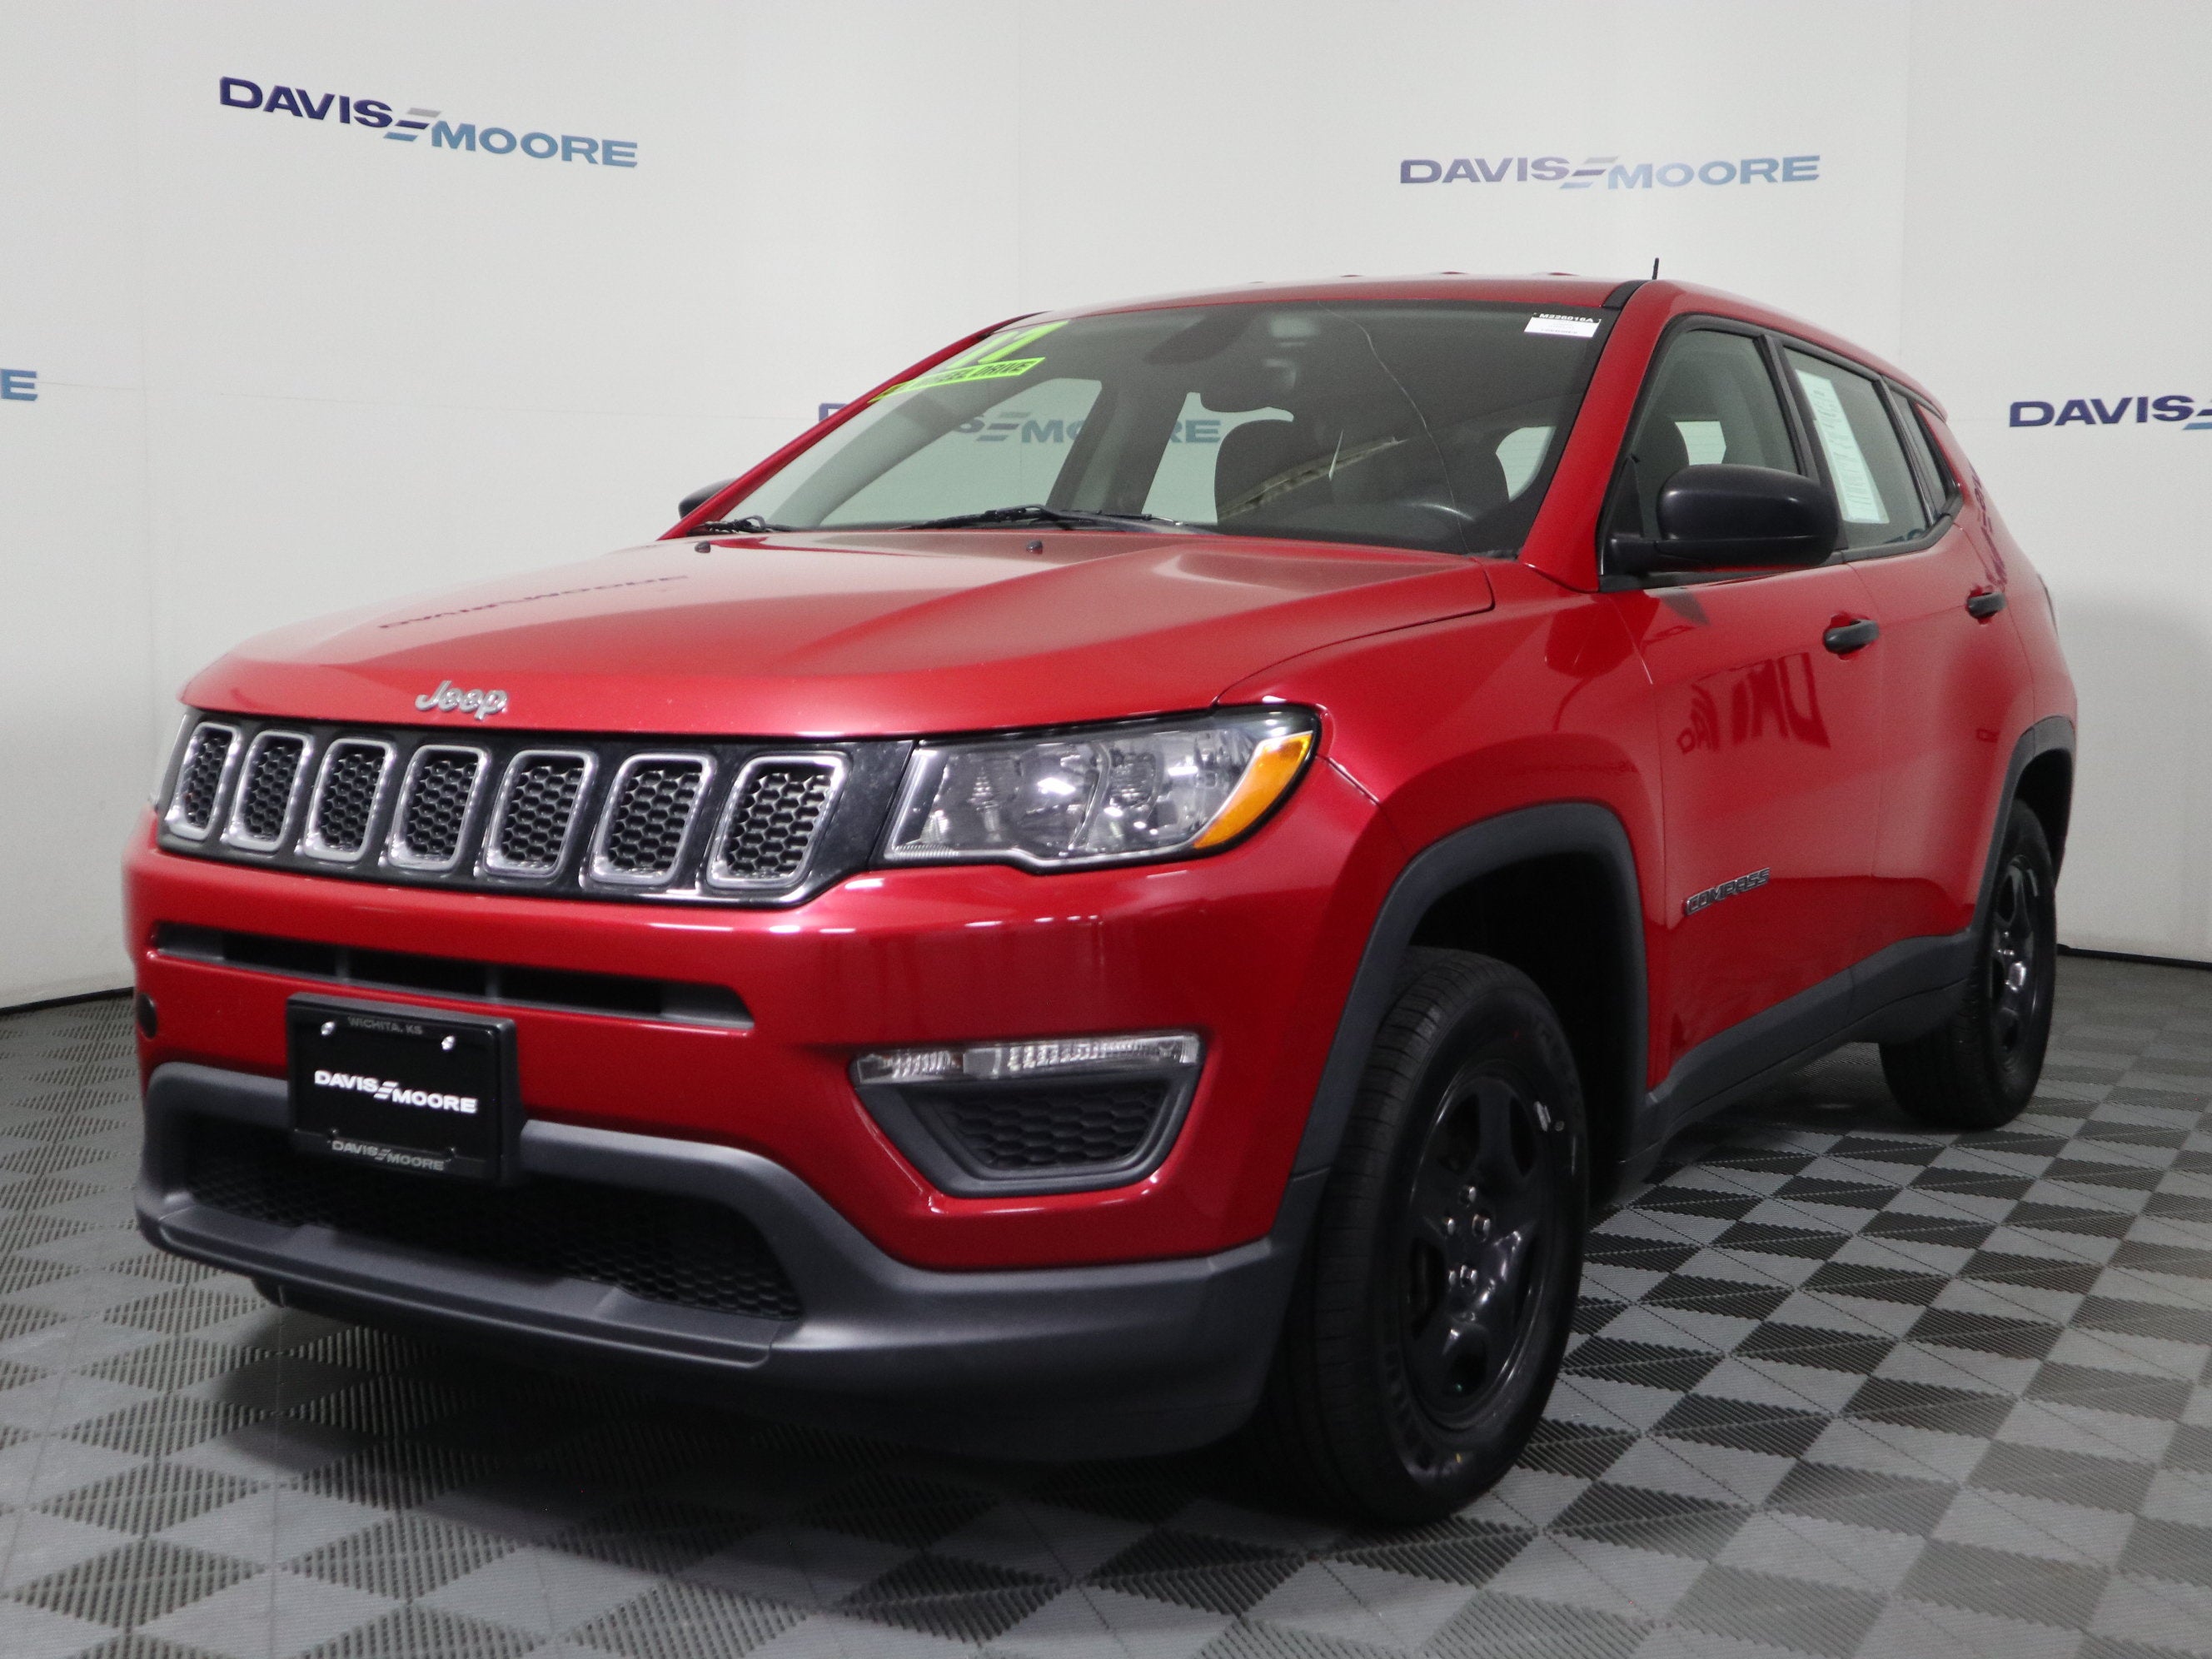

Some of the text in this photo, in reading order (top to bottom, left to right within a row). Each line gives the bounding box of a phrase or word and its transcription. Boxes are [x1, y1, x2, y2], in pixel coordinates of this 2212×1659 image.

[219, 76, 637, 167] DAVIS MOORE
[1400, 155, 1821, 189] DAVIS MOORE
[2009, 395, 2195, 427] DAVIS
[415, 680, 509, 721] Jeep
[1686, 867, 1770, 916] COMPASS
[406, 1023, 423, 1035] KS
[314, 1069, 478, 1114] DAVIS MOORE
[331, 1139, 445, 1171] DAVIS MOORE
